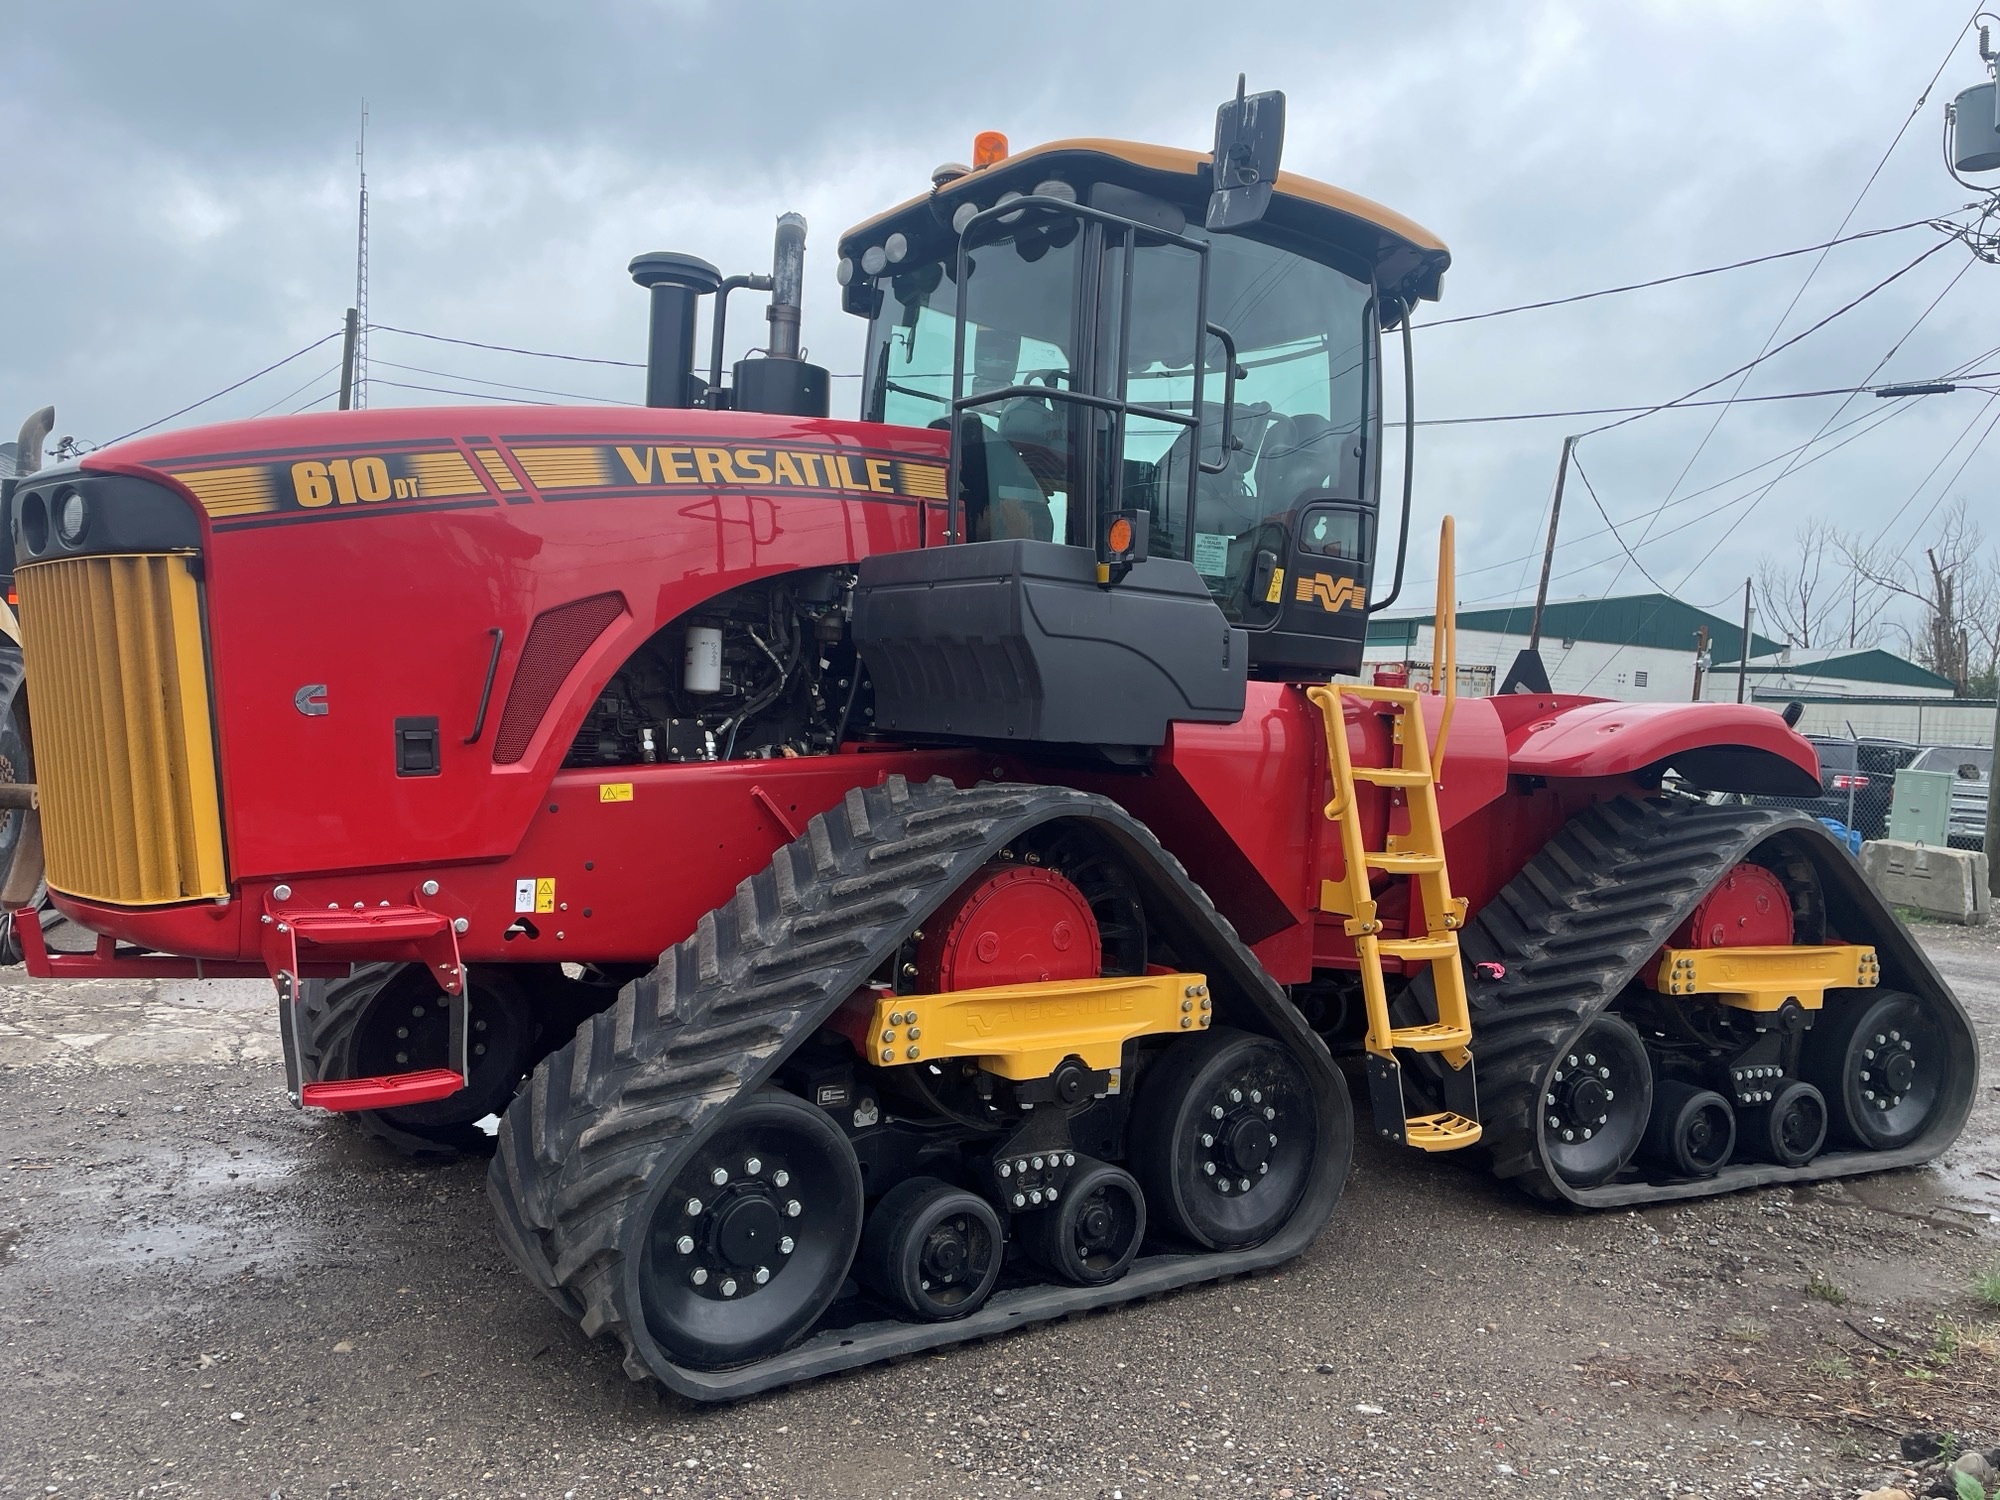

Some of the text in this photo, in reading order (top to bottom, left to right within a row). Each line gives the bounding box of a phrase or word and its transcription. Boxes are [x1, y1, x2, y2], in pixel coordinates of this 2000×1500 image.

[291, 457, 419, 507] 610 DT
[615, 447, 894, 493] VERSATILE
